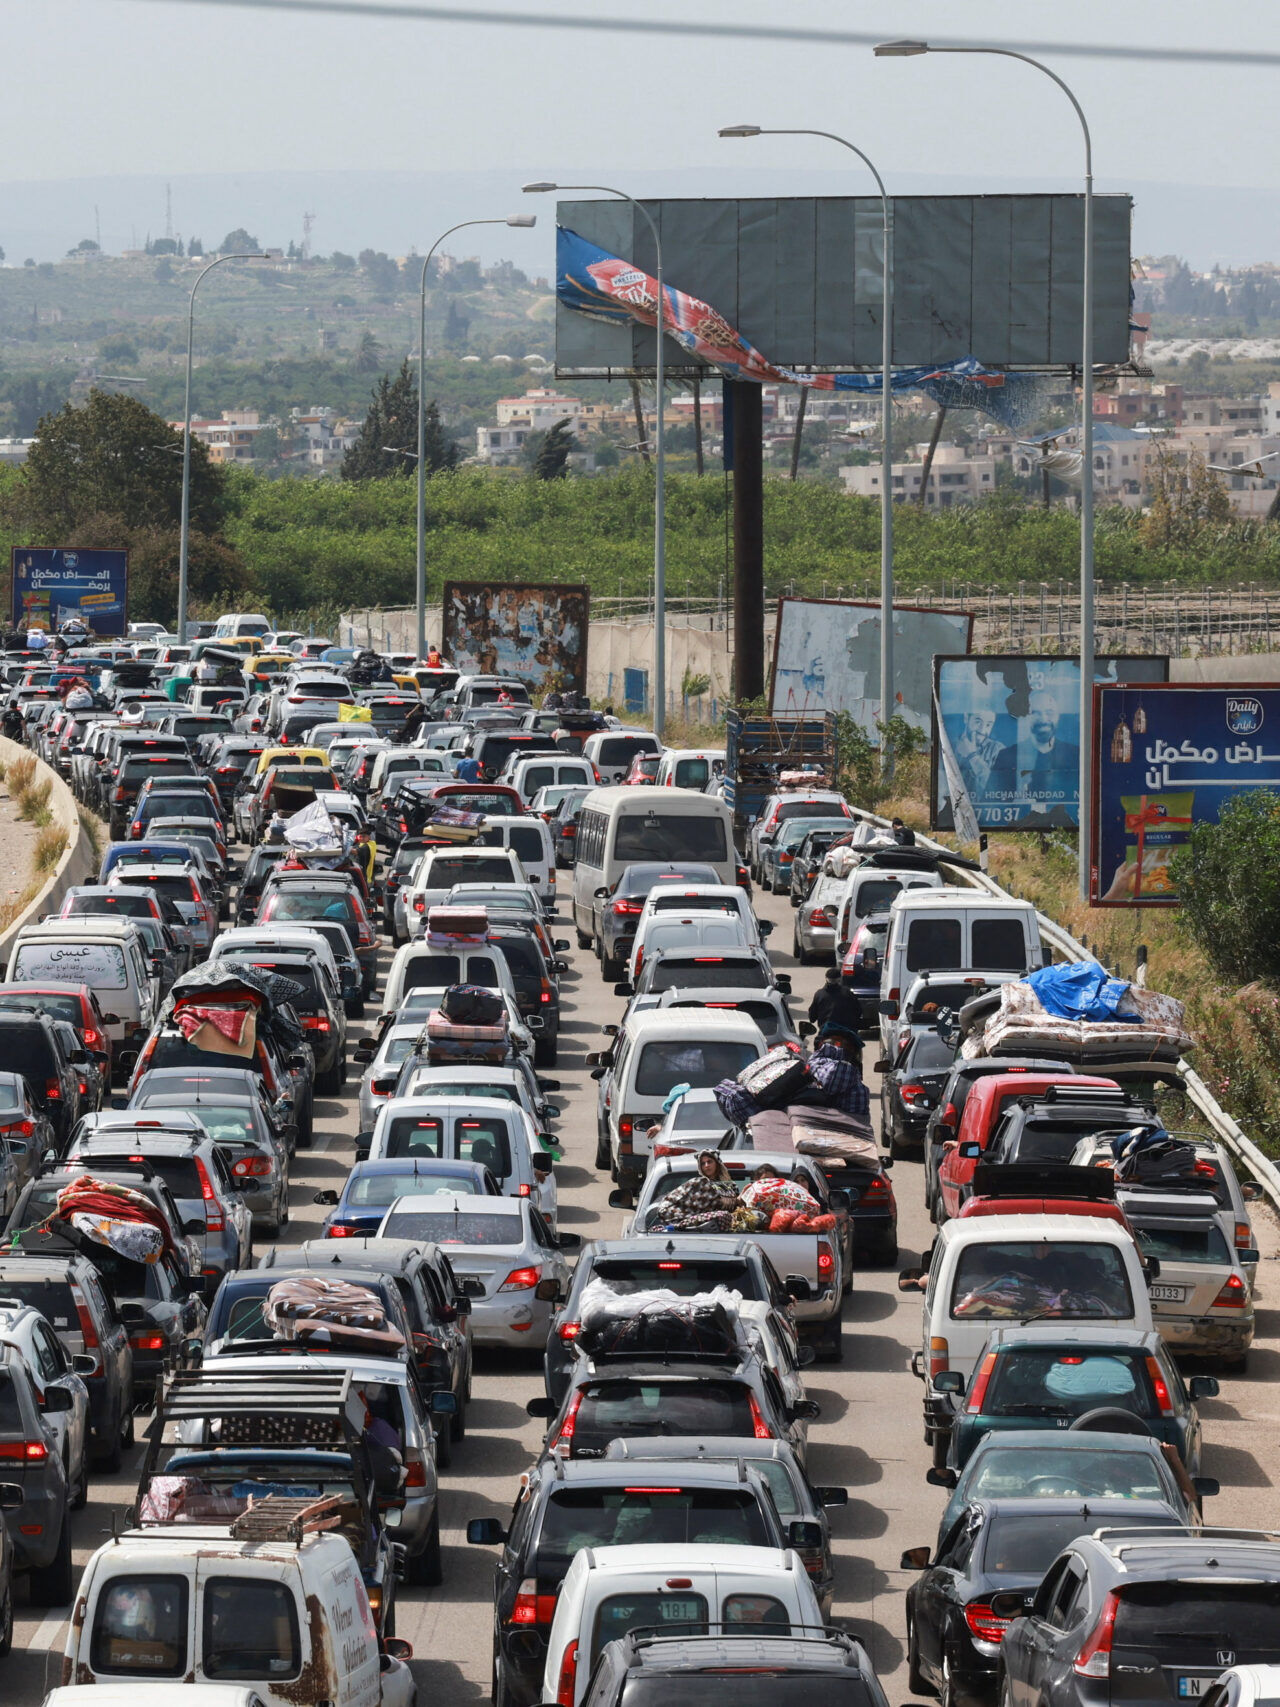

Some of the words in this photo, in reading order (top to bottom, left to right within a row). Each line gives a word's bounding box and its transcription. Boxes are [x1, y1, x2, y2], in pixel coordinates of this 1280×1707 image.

[1228, 700, 1259, 715] Daily
[1023, 791, 1065, 799] HADDAD
[985, 807, 1001, 822] 70
[1003, 807, 1020, 822] 37
[50, 947, 91, 961] عيسى
[1191, 1679, 1200, 1695] N
